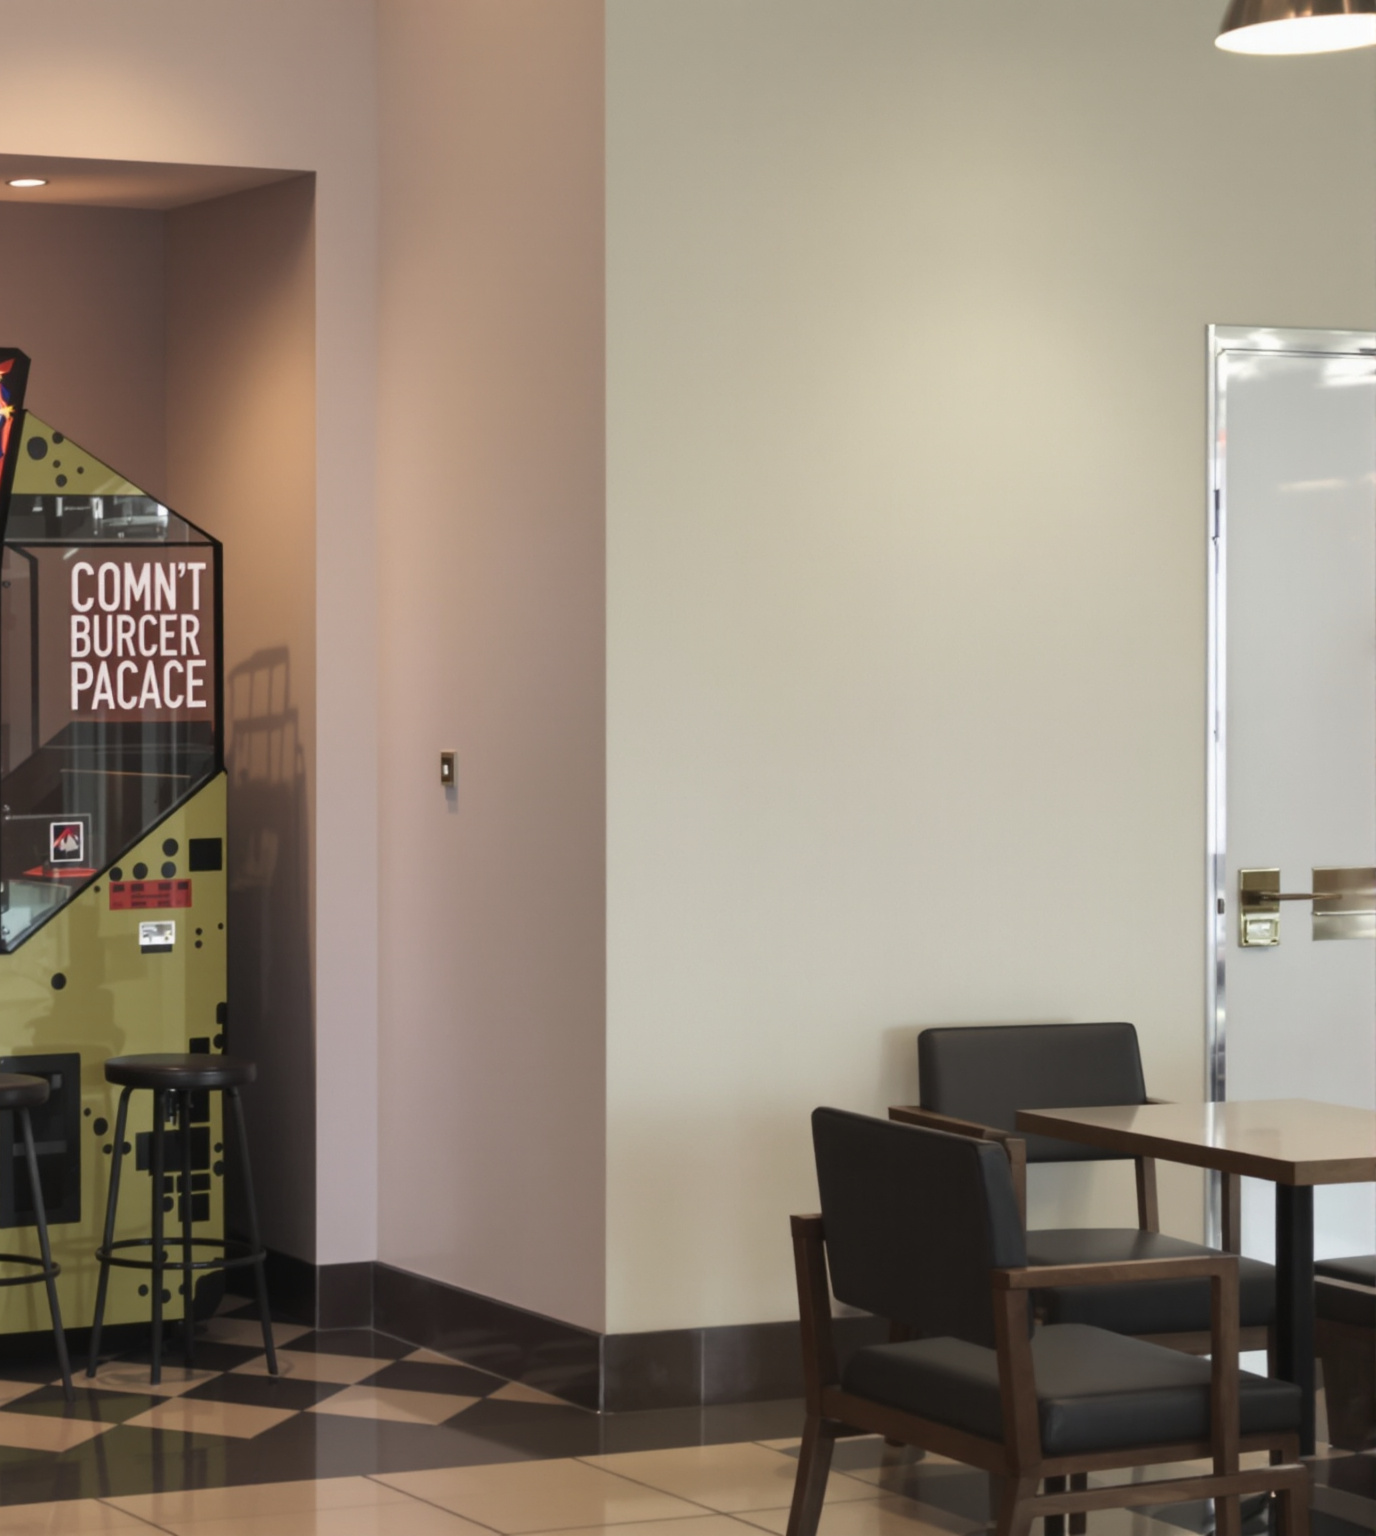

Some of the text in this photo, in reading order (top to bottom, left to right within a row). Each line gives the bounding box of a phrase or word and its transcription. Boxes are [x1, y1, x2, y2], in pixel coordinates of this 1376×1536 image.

[71, 561, 206, 612] COMN'T
[71, 614, 200, 658] BURCER
[71, 659, 206, 710] PACACE
